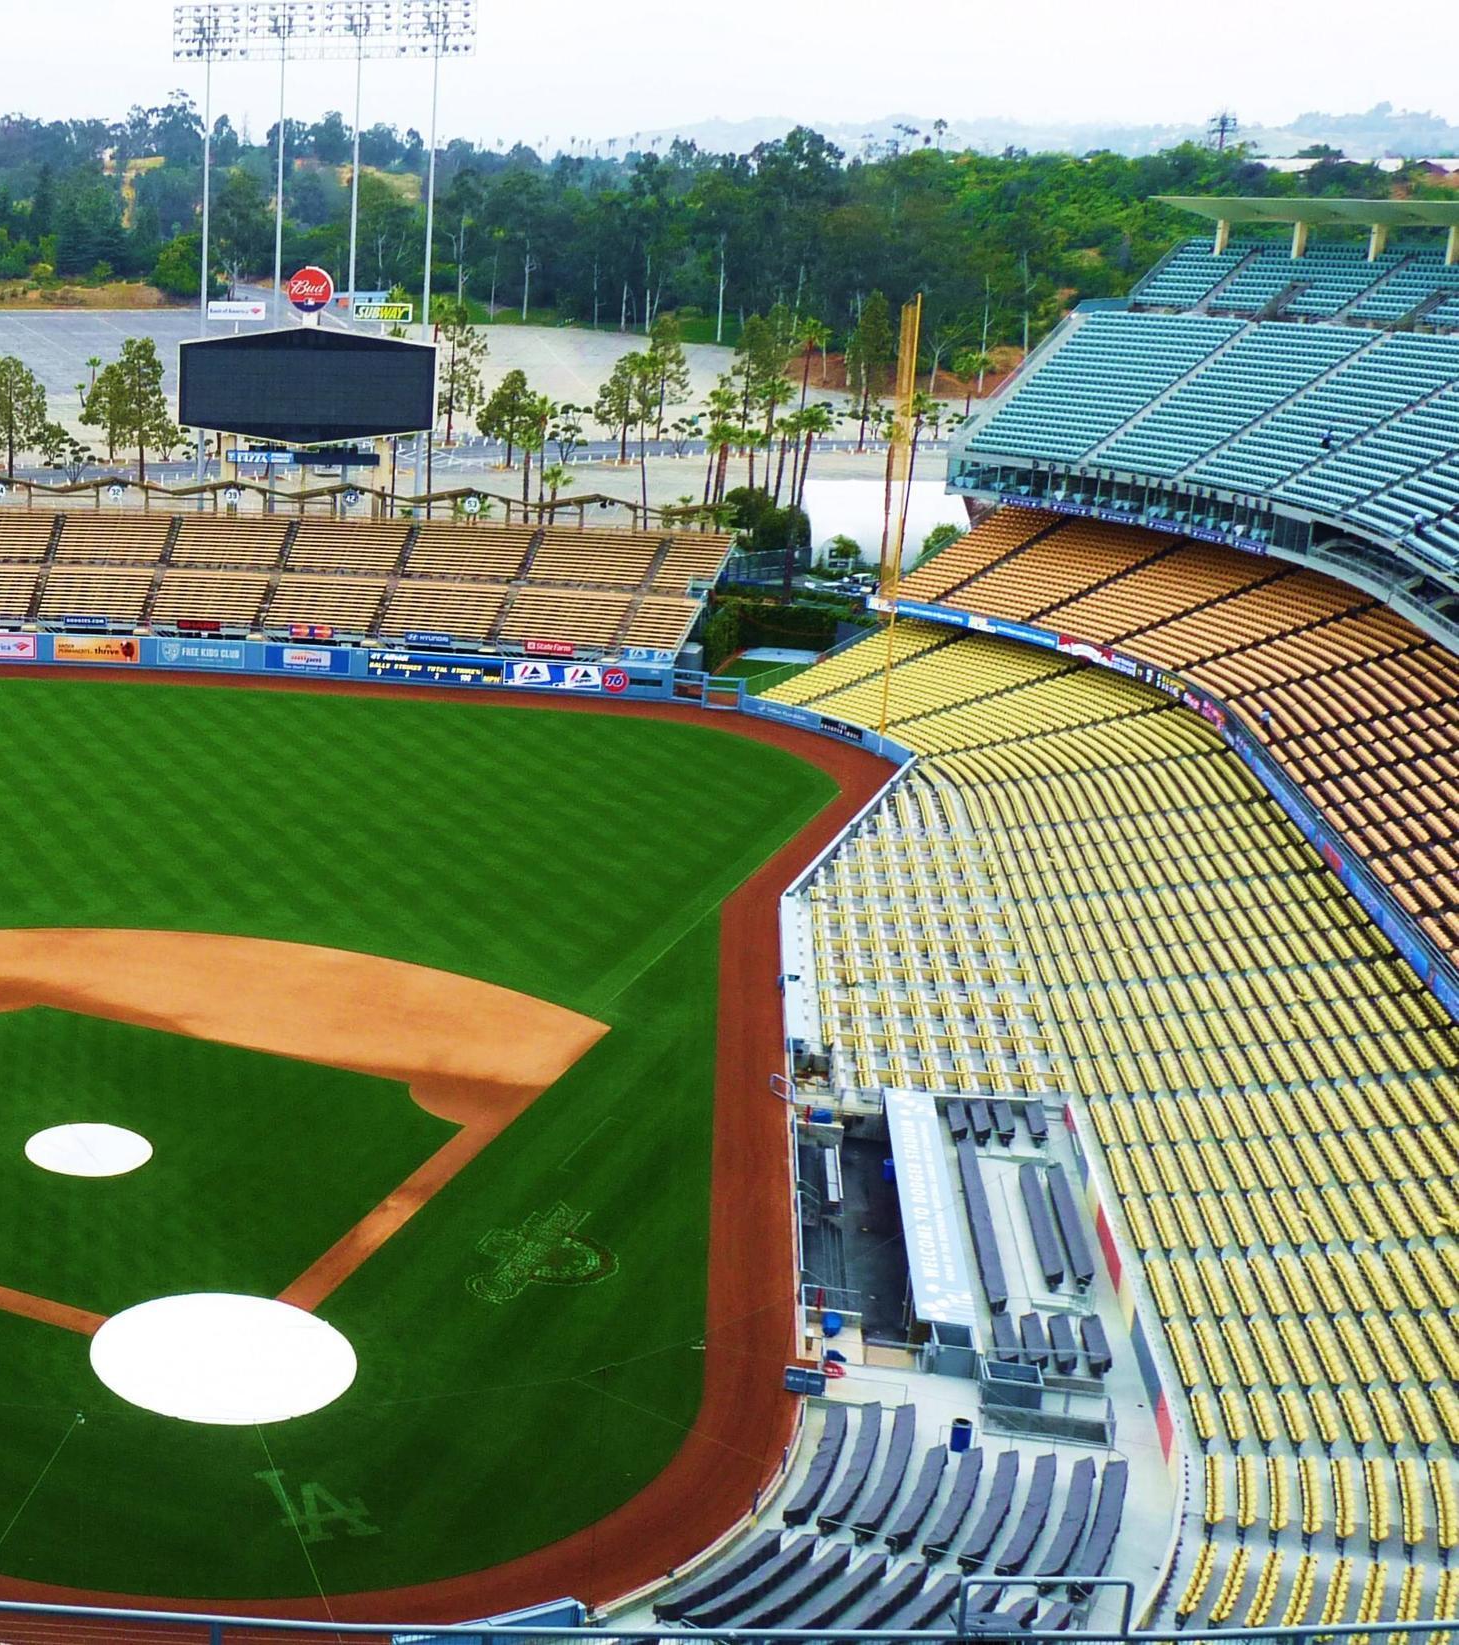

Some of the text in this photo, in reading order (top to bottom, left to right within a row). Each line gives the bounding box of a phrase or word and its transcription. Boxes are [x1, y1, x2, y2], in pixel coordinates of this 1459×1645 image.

[290, 280, 327, 294] Bud
[356, 307, 408, 318] SUBWAY
[94, 646, 119, 655] thrive
[182, 647, 199, 656] FREE
[220, 650, 240, 658] CLUB
[536, 642, 572, 652] State Farm
[605, 673, 624, 687] 76
[900, 1119, 940, 1278] WELCOME TO DODGER STADIUM
[254, 1468, 381, 1544] LA
